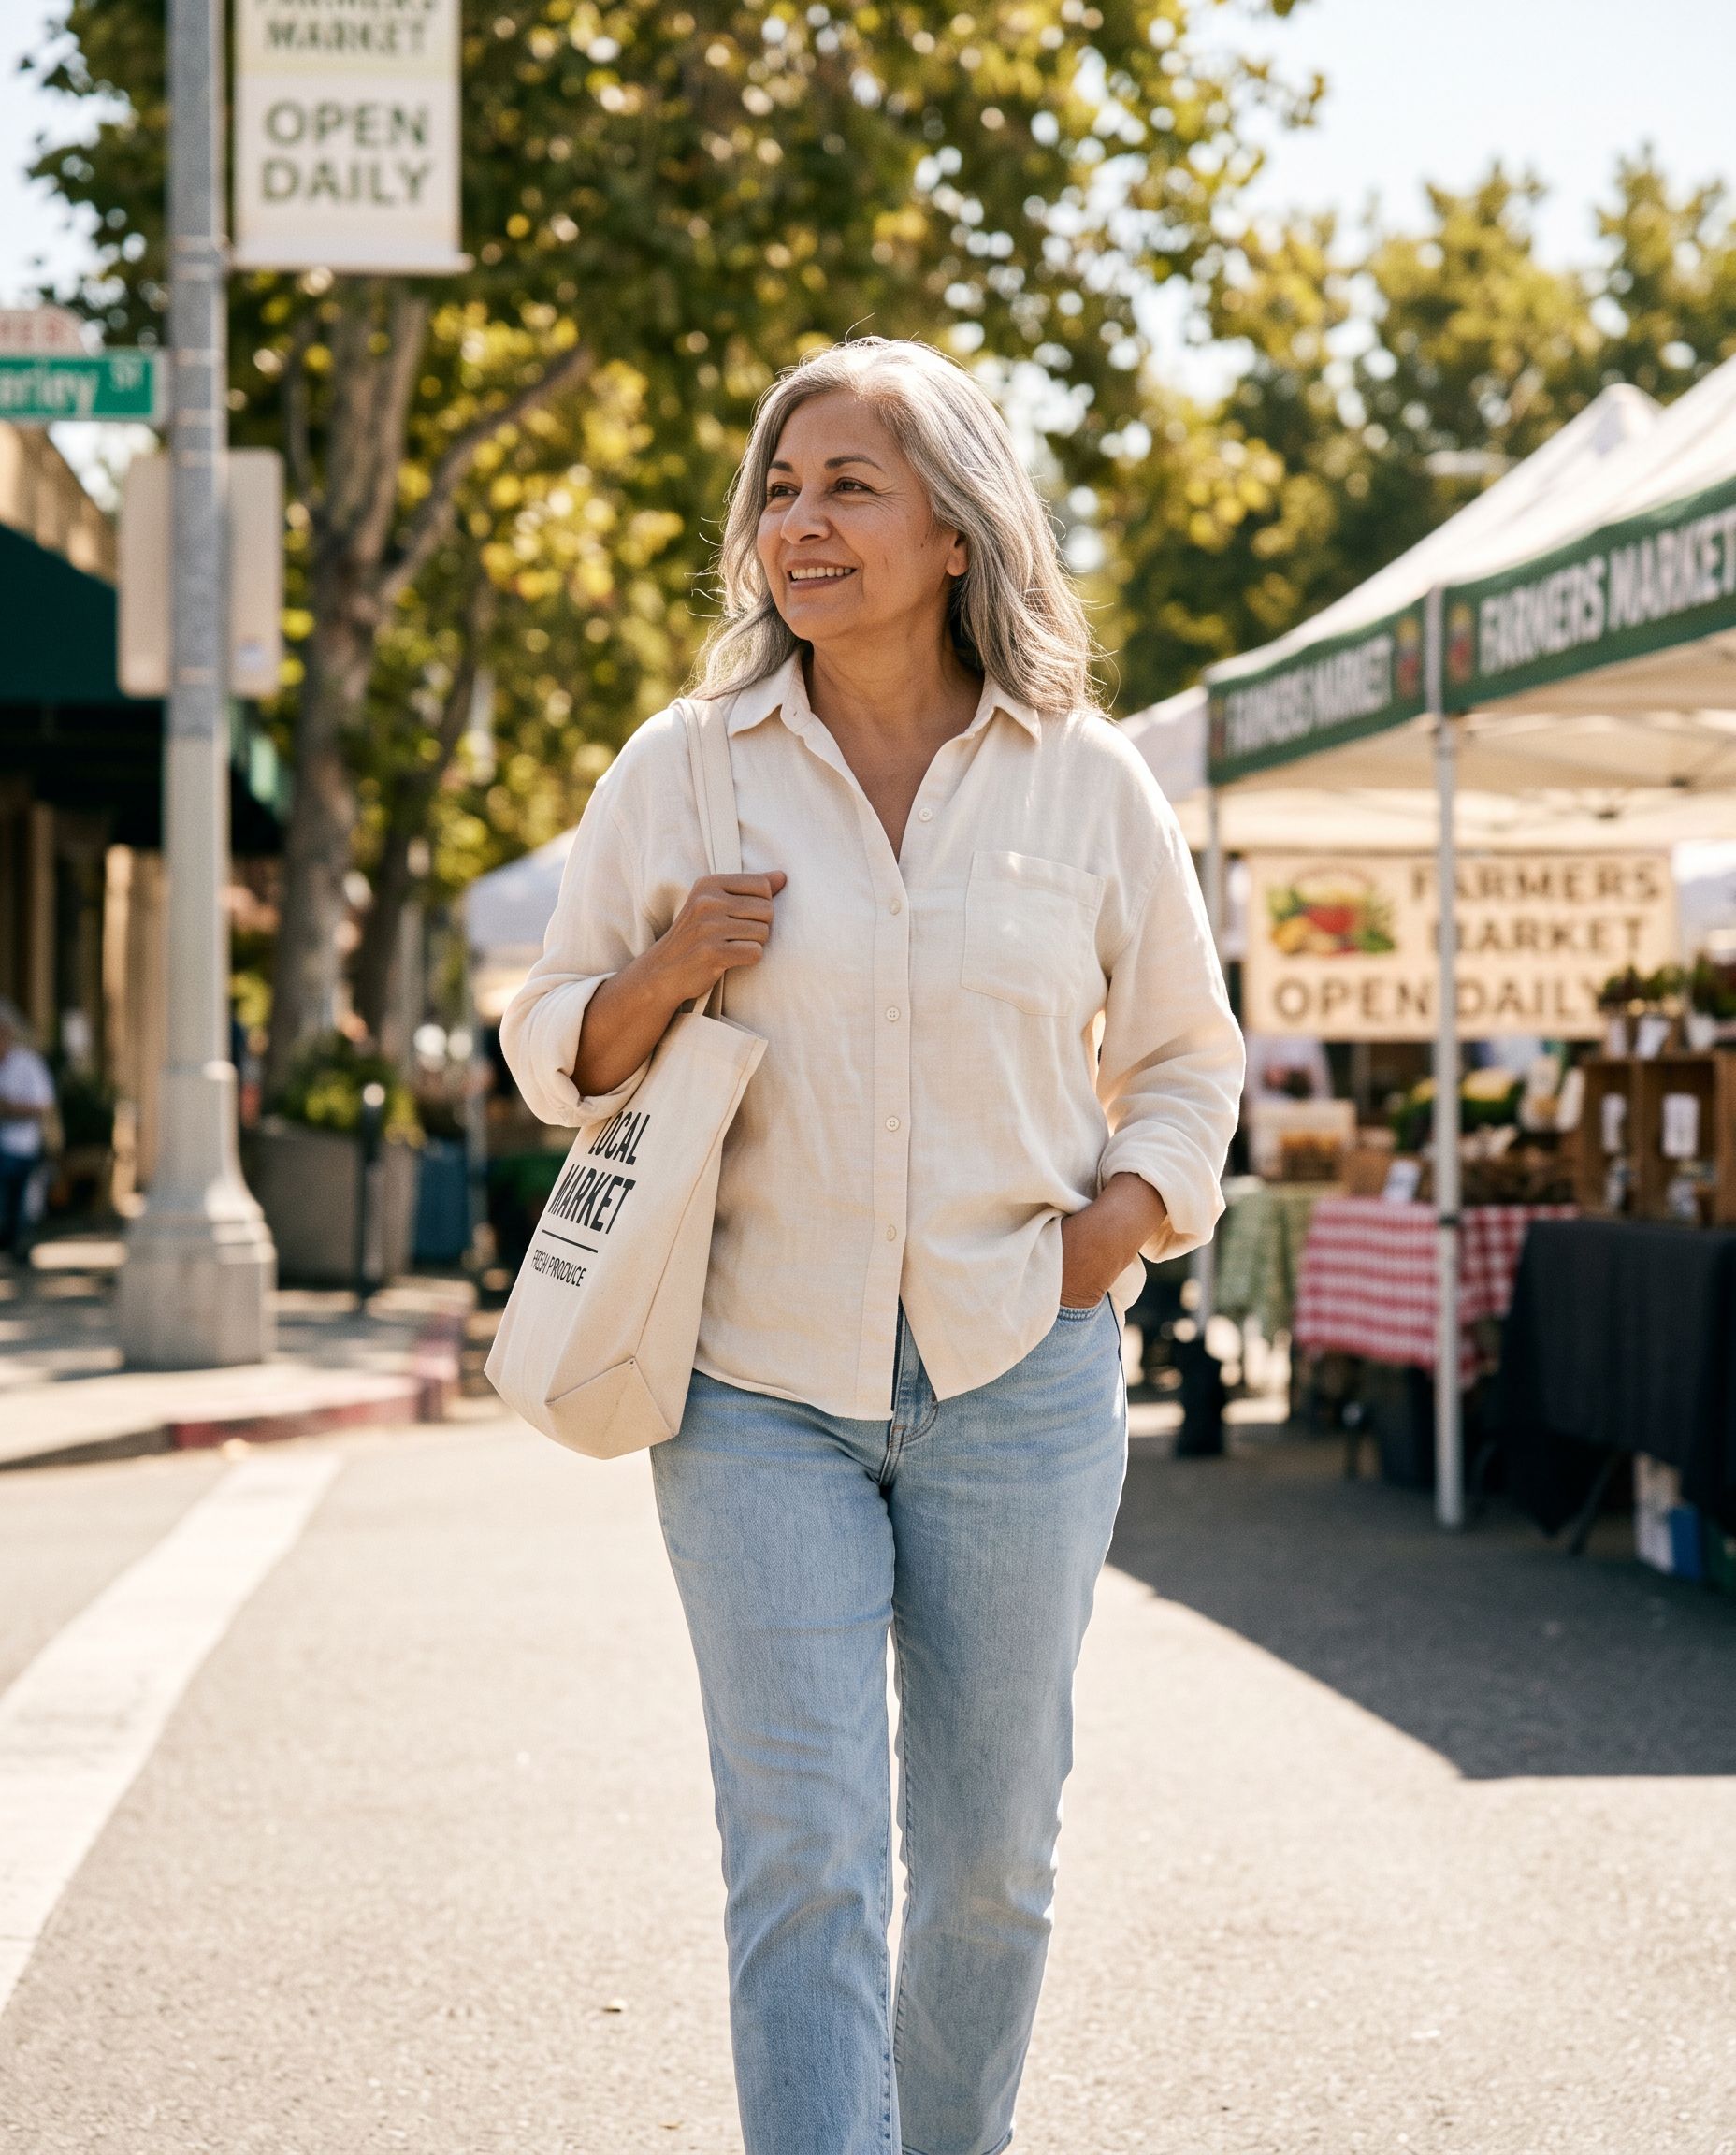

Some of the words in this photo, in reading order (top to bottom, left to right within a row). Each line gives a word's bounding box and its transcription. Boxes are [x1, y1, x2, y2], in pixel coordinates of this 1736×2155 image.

[266, 20, 426, 54] MARKET
[266, 100, 429, 147] OPEN
[262, 158, 432, 204] DAILY
[1480, 555, 1606, 677] FARMERS
[1607, 504, 1736, 632] MARKET
[1311, 633, 1392, 728] MARKET
[1273, 976, 1431, 1022] OPEN
[588, 1111, 651, 1165] LOCAL
[548, 1164, 636, 1235] MARKET
[548, 1256, 587, 1287] PRODUCE
